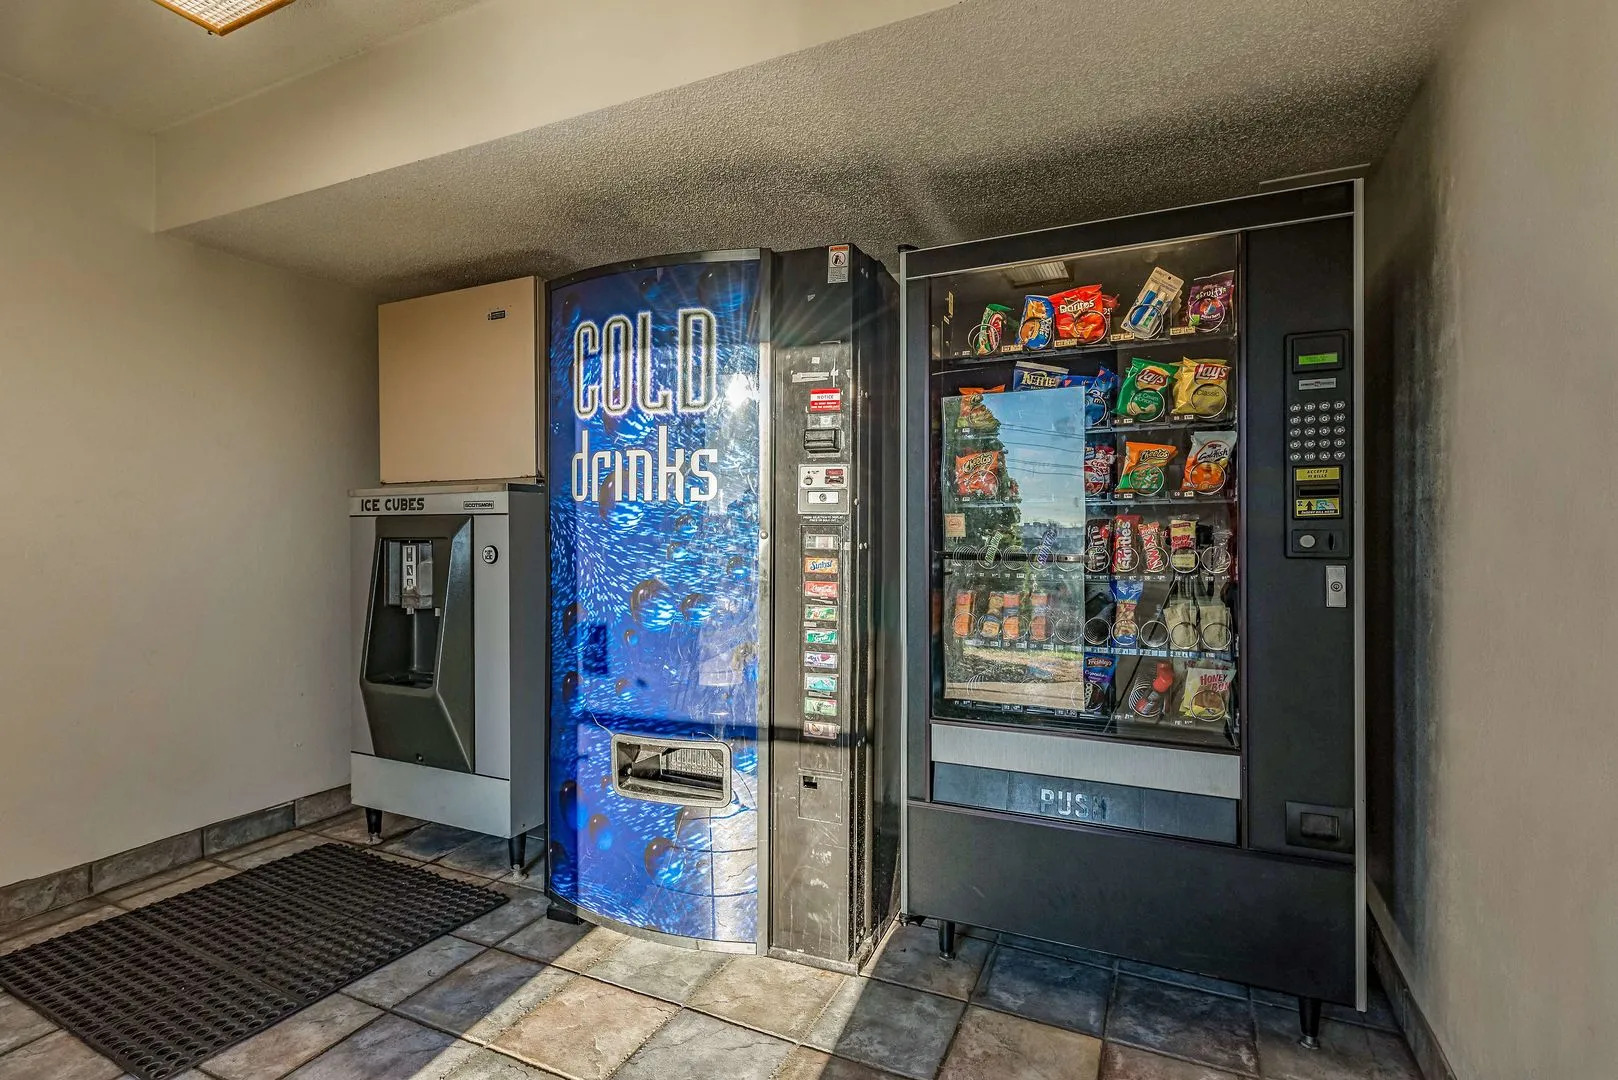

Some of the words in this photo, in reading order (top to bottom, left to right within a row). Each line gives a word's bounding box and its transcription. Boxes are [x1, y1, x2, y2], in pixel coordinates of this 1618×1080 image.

[1058, 299, 1095, 314] Doritos
[573, 308, 717, 419] COLD
[1196, 389, 1220, 397] Classic
[571, 425, 718, 504] drinks
[963, 452, 994, 474] Cheetos
[360, 498, 380, 512] ICE
[384, 497, 425, 511] CUBES
[1200, 673, 1228, 686] HONEY
[1211, 682, 1231, 692] BUN
